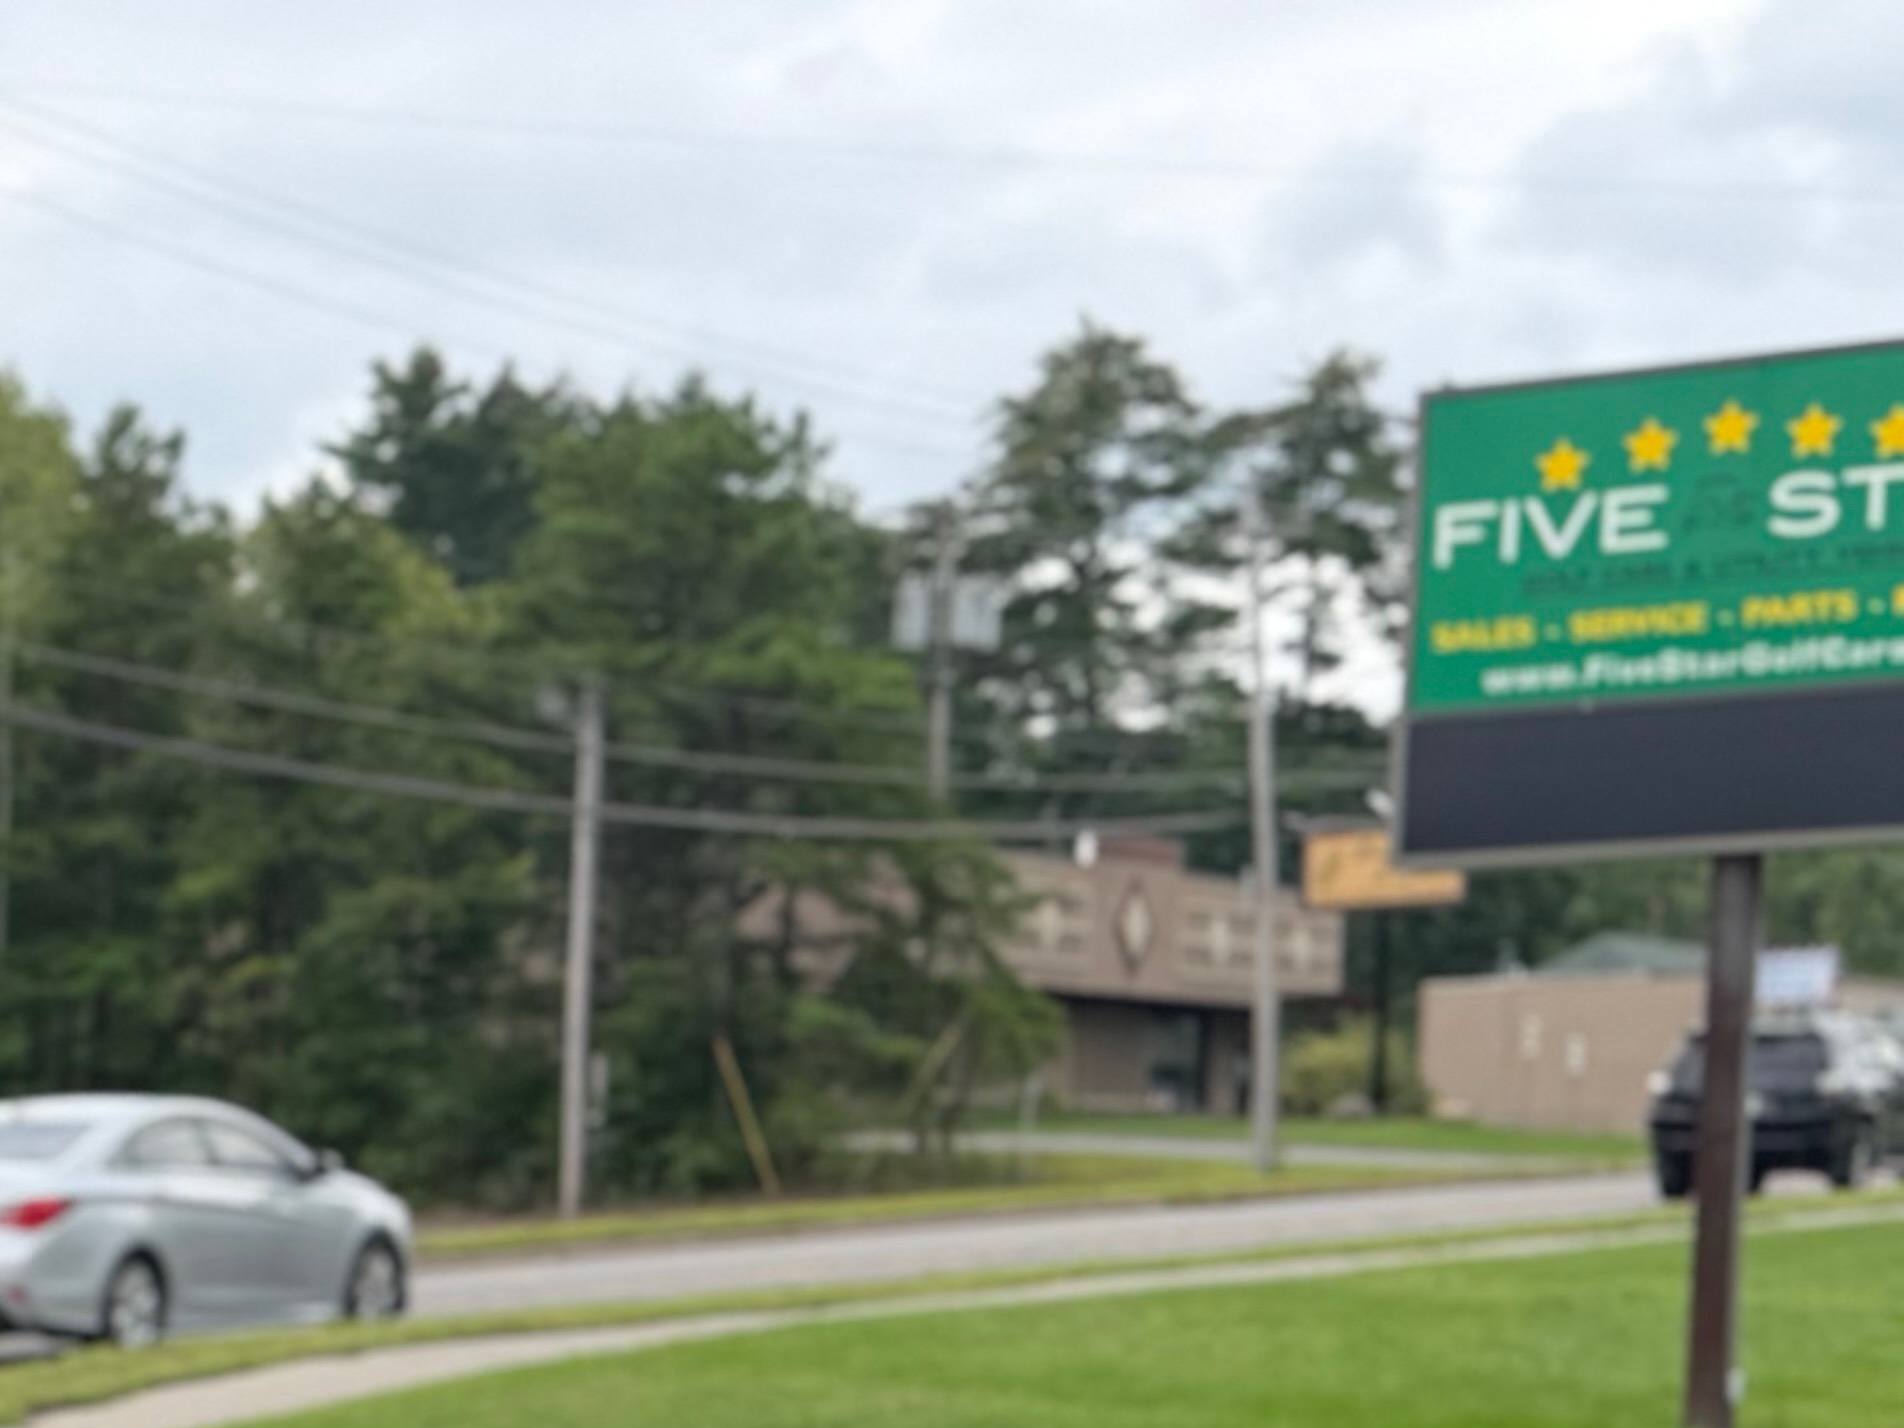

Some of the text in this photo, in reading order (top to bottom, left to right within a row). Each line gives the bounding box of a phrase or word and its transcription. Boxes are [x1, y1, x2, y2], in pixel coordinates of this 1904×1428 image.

[1433, 483, 1670, 568] FIVE
[1768, 461, 1904, 538] ST
[1431, 616, 1536, 651] SALES
[1568, 604, 1708, 643] SERVICE
[1741, 590, 1858, 629] PARTS
